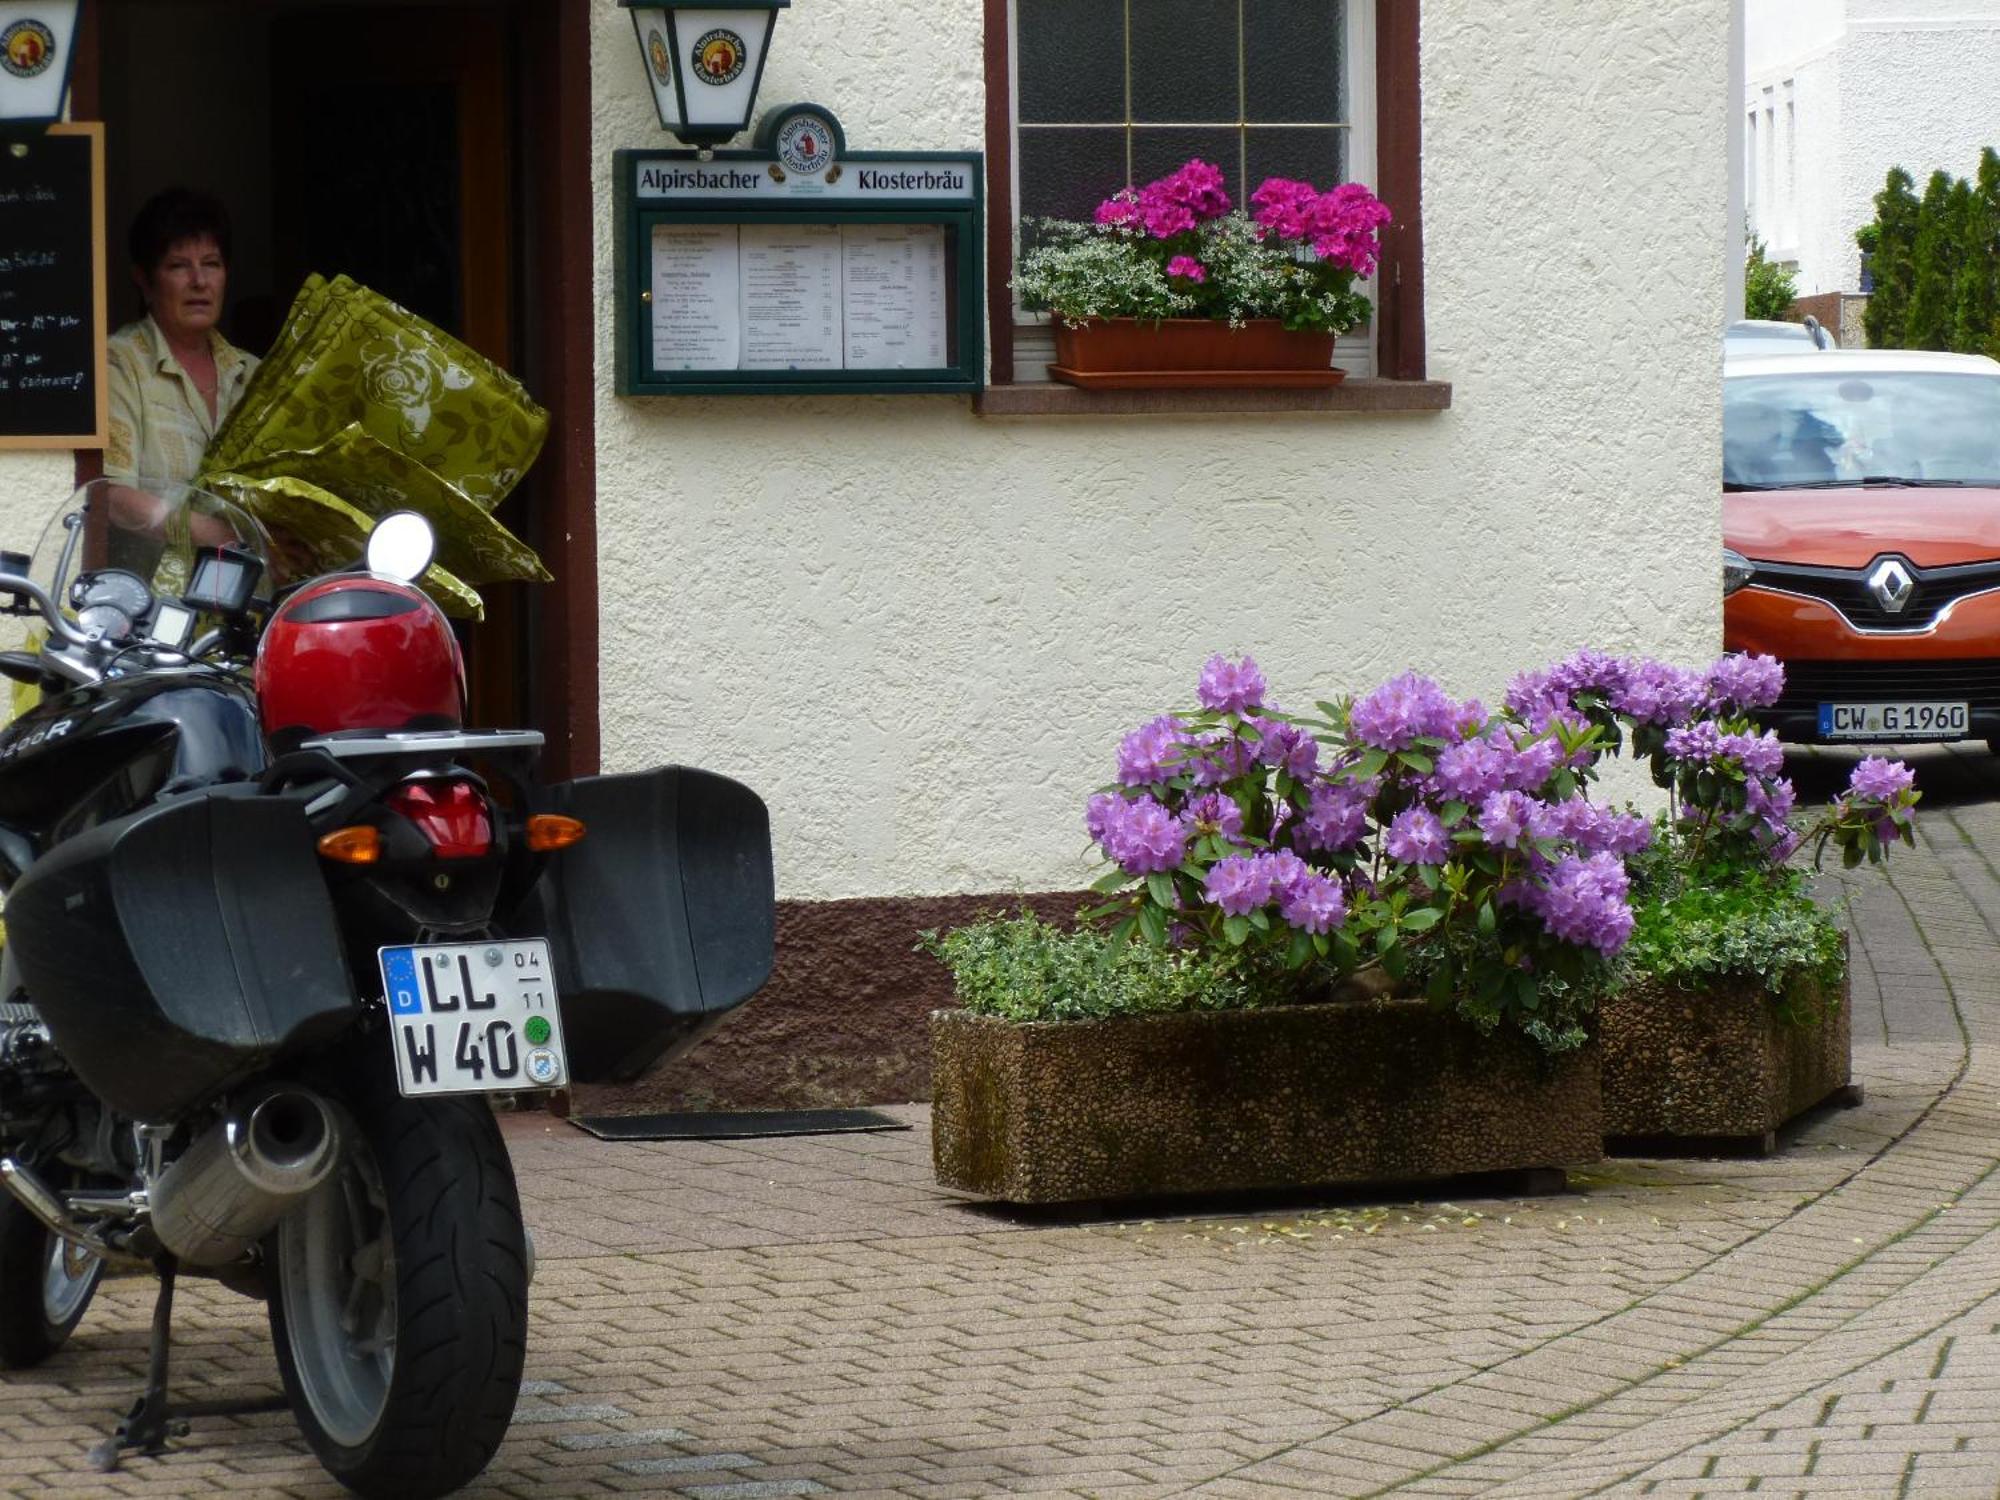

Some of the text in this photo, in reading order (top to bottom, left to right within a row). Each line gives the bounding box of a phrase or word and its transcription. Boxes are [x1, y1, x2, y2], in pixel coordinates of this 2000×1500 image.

[695, 31, 744, 56] Alpirsbacher
[781, 119, 828, 144] Alpirsbacher
[641, 169, 964, 193] Alpirsbacher Klosterbräu
[1834, 707, 1866, 730] CW
[1883, 707, 1899, 730] G
[1904, 706, 1965, 730] 1960
[514, 952, 539, 967] 04
[421, 955, 496, 1012] LL
[398, 991, 412, 1007] D
[523, 992, 544, 1009] 11
[403, 1023, 438, 1084] W
[455, 1020, 519, 1080] 40
